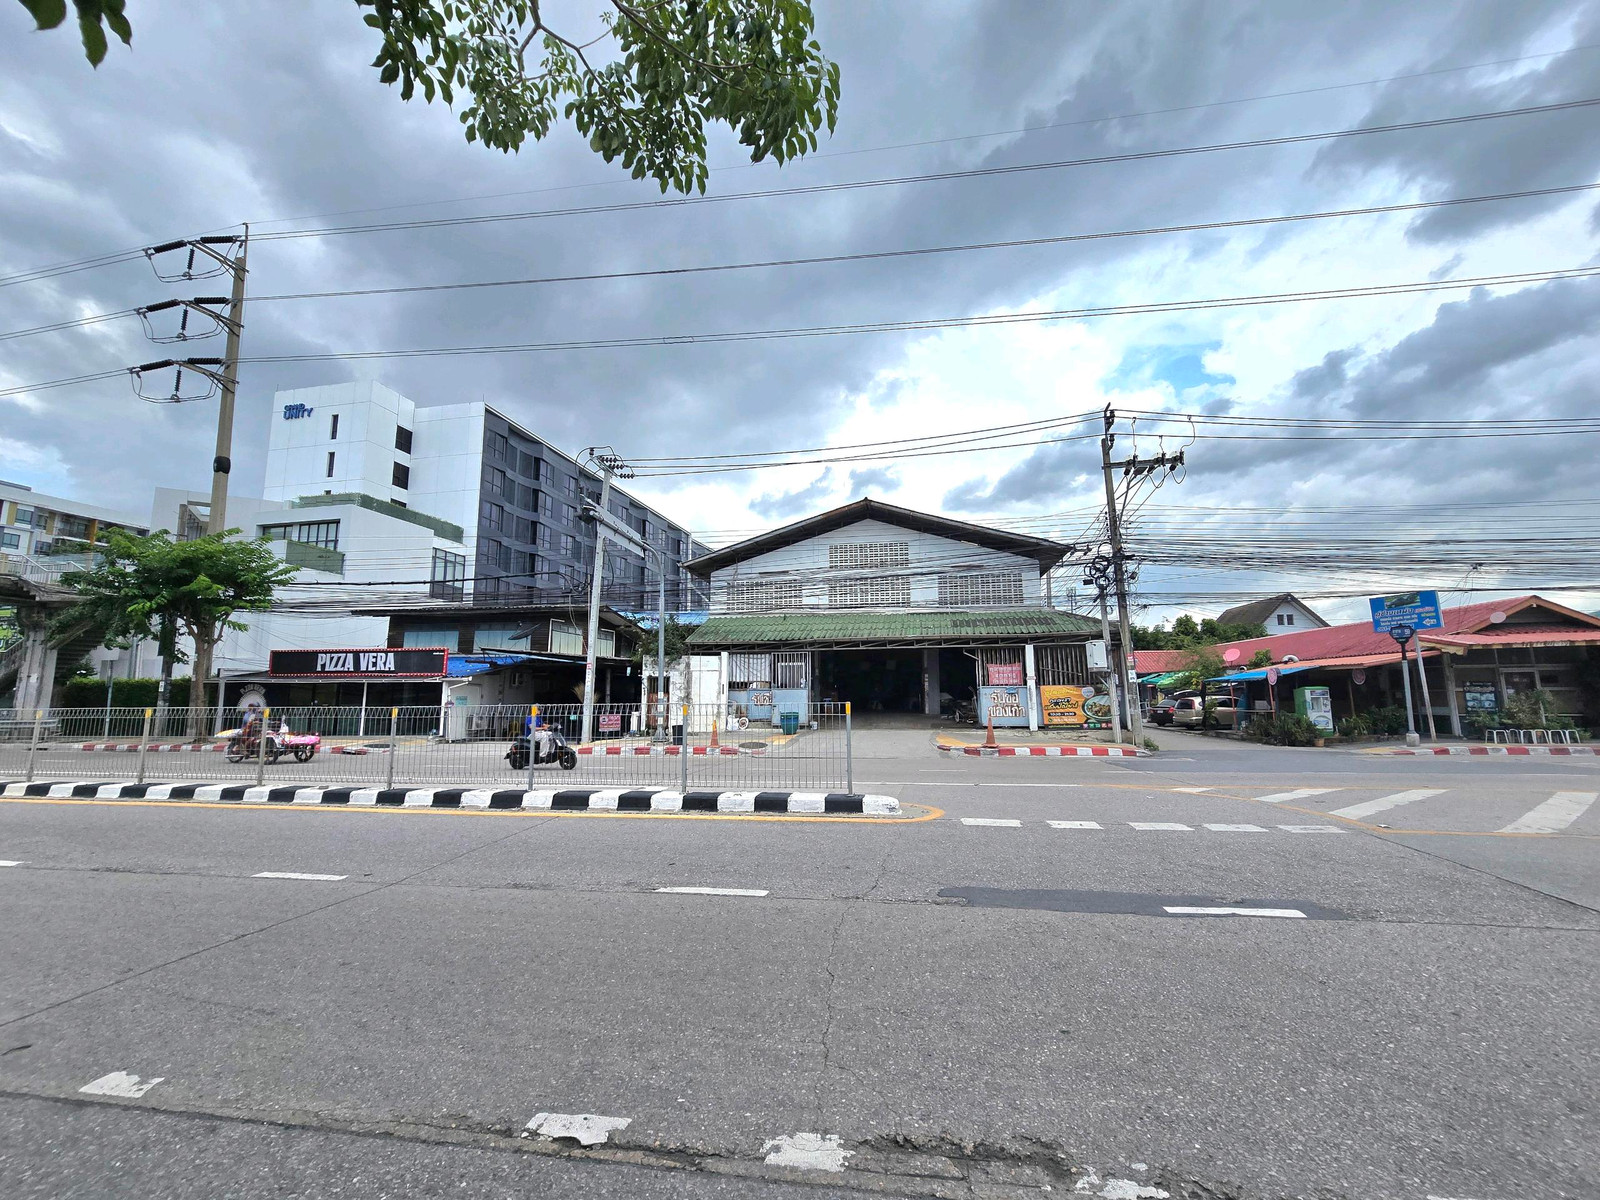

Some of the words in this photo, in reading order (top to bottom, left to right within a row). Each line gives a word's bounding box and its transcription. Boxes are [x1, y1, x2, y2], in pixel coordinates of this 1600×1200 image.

[283, 407, 314, 420] UNITY
[316, 652, 354, 671] PIZZA
[359, 652, 395, 671] VERA
